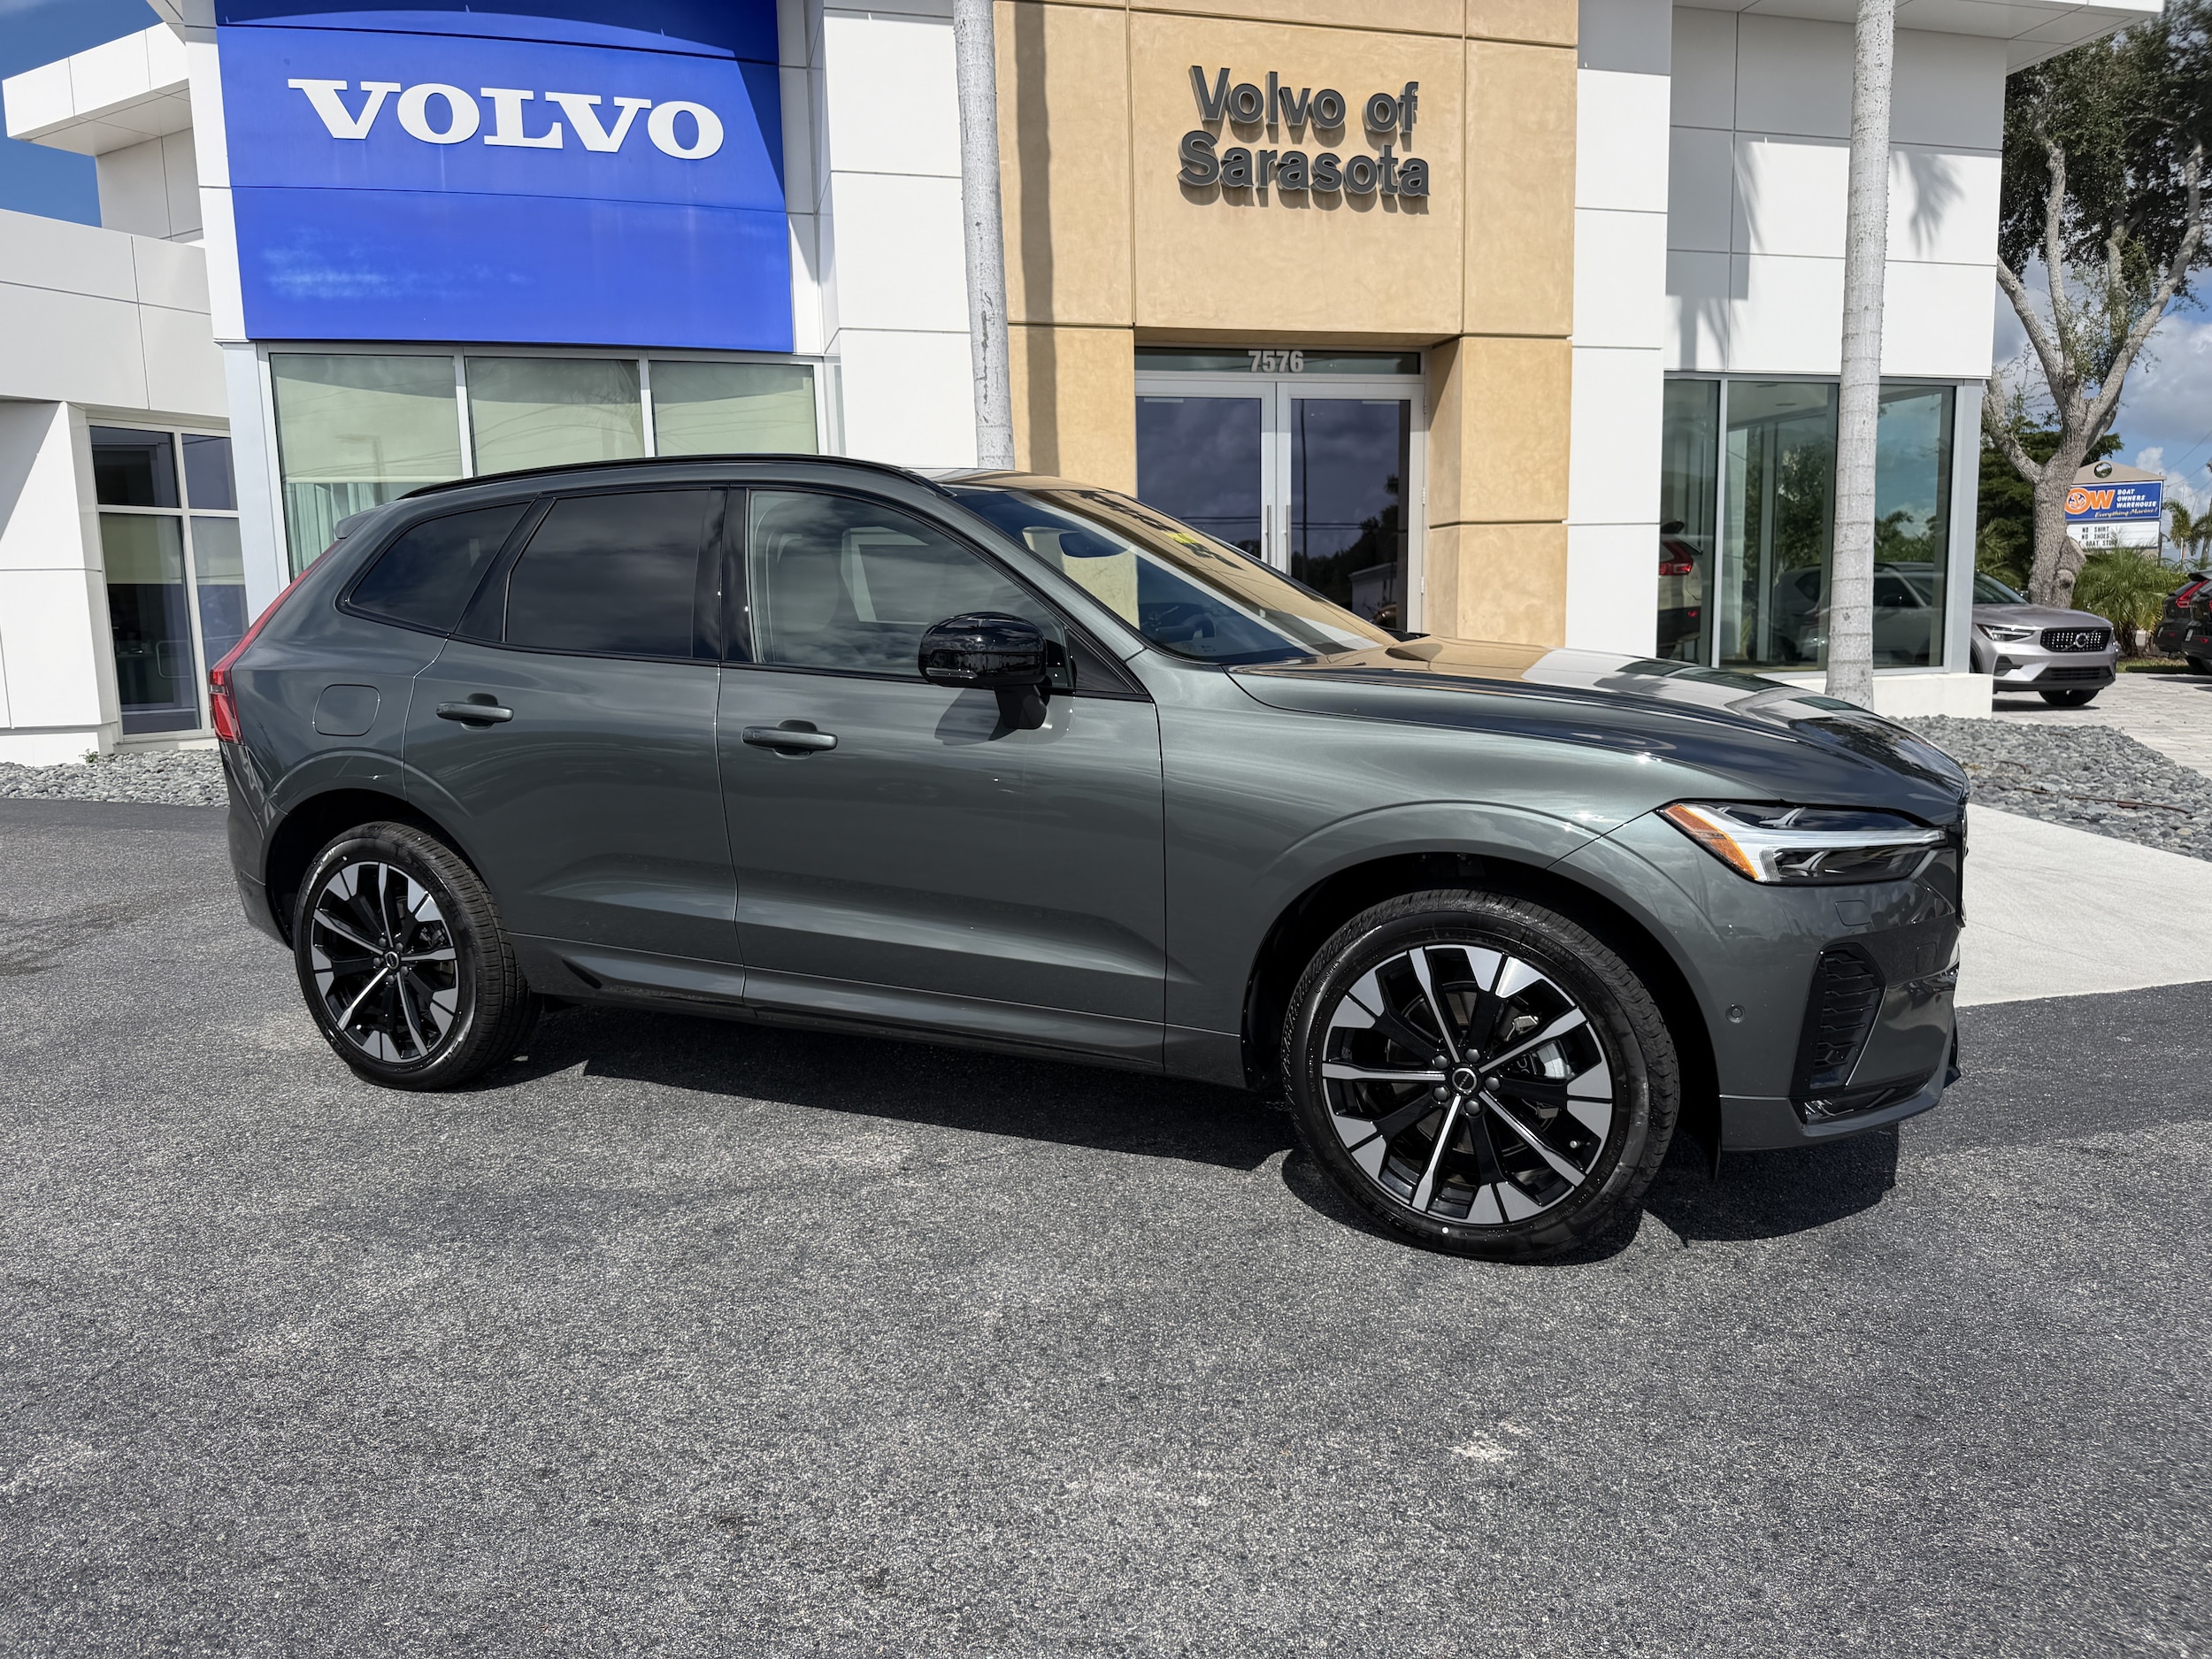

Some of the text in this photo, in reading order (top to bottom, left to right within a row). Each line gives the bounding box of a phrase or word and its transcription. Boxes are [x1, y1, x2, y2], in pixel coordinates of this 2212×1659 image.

[287, 78, 725, 160] VOLVO
[1189, 65, 1419, 134] Volvo of
[1179, 130, 1430, 197] Sarasota
[1248, 350, 1304, 373] 7576
[2064, 488, 2115, 515] OW
